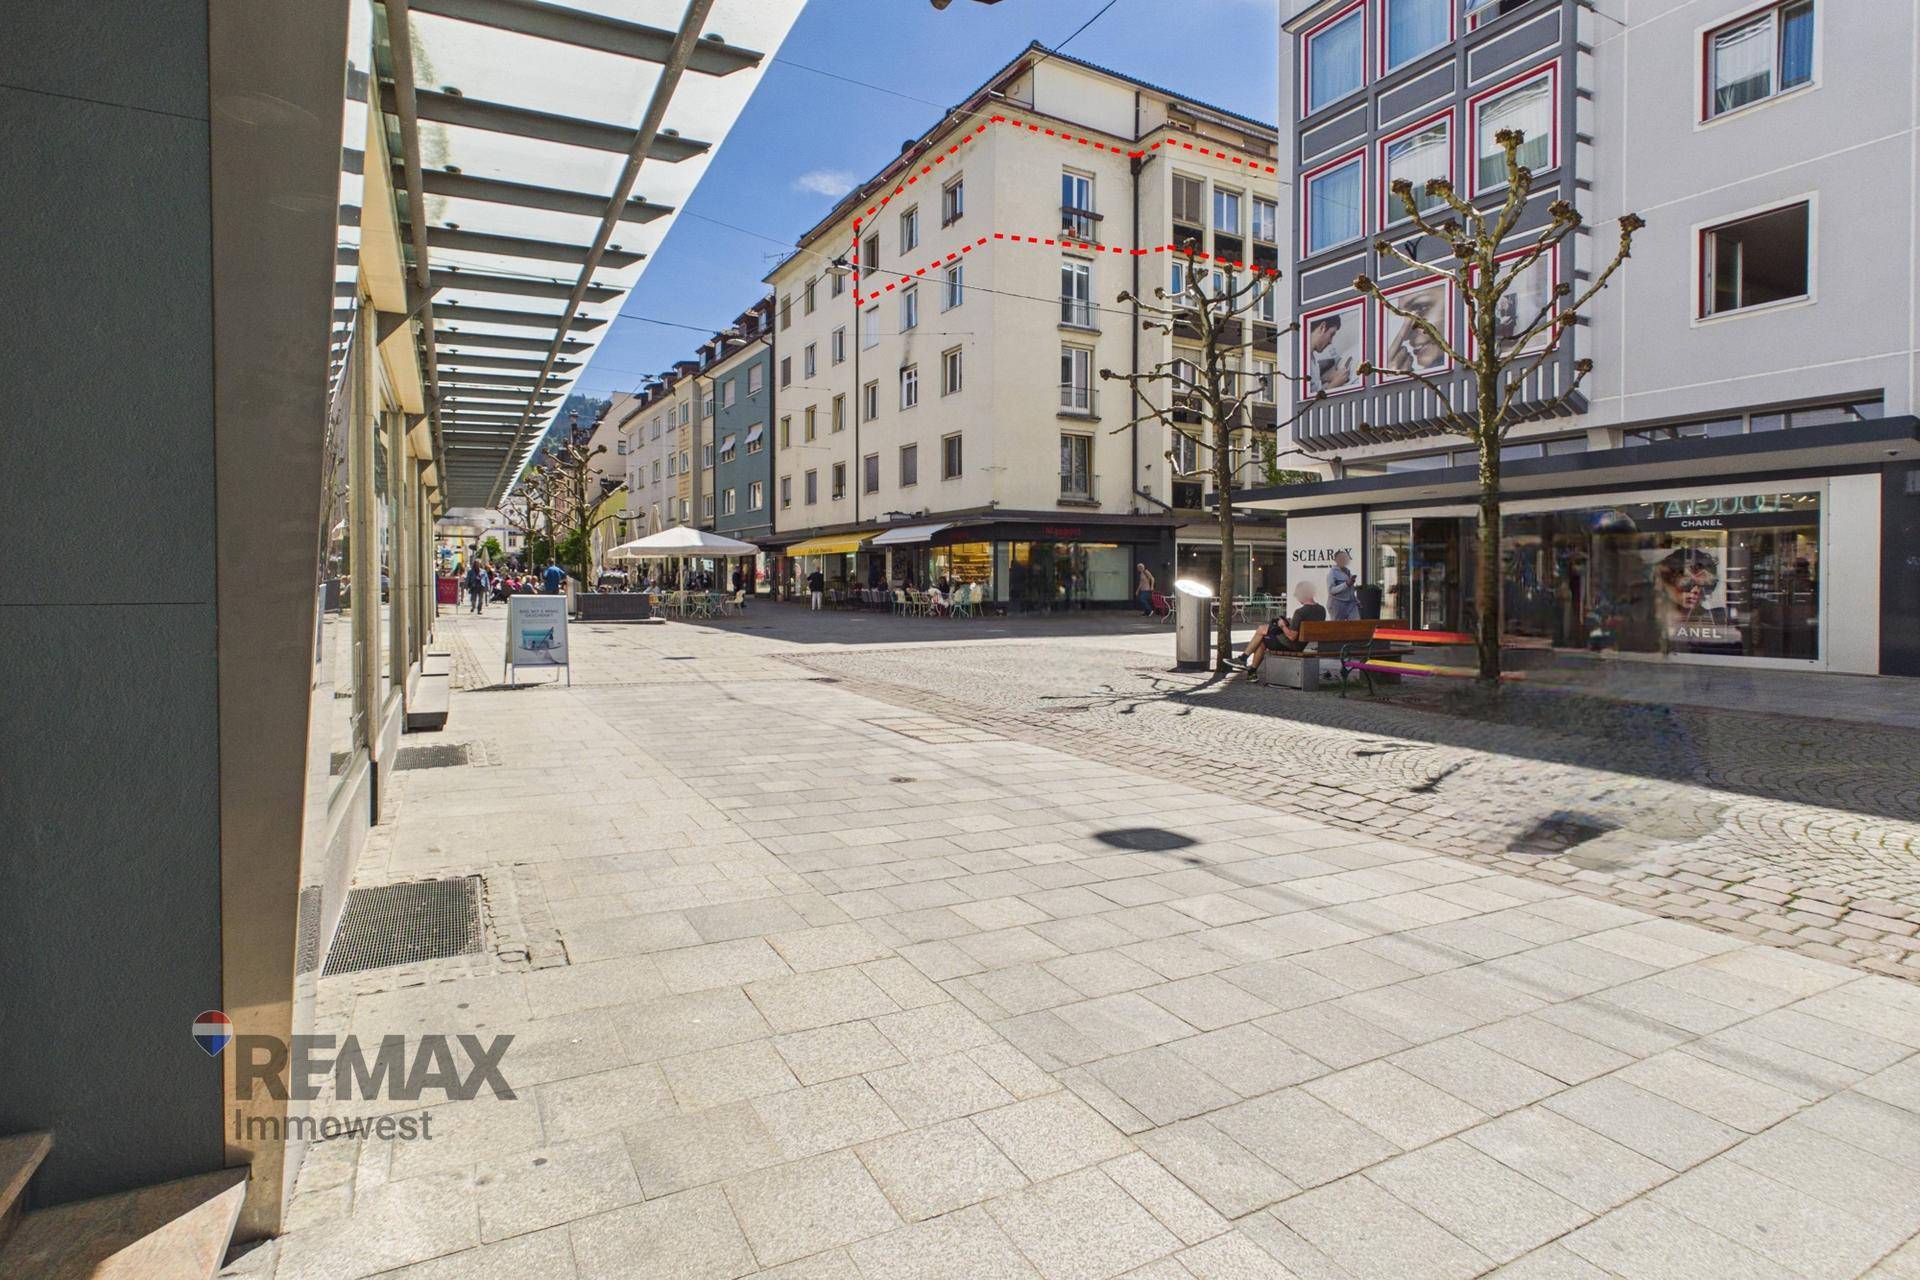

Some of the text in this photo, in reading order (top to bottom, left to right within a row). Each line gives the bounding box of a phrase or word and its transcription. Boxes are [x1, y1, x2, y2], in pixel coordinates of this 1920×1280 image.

[1681, 518, 1723, 528] CHANEL
[1292, 547, 1353, 562] SCHARX
[1677, 626, 1722, 639] ANEL
